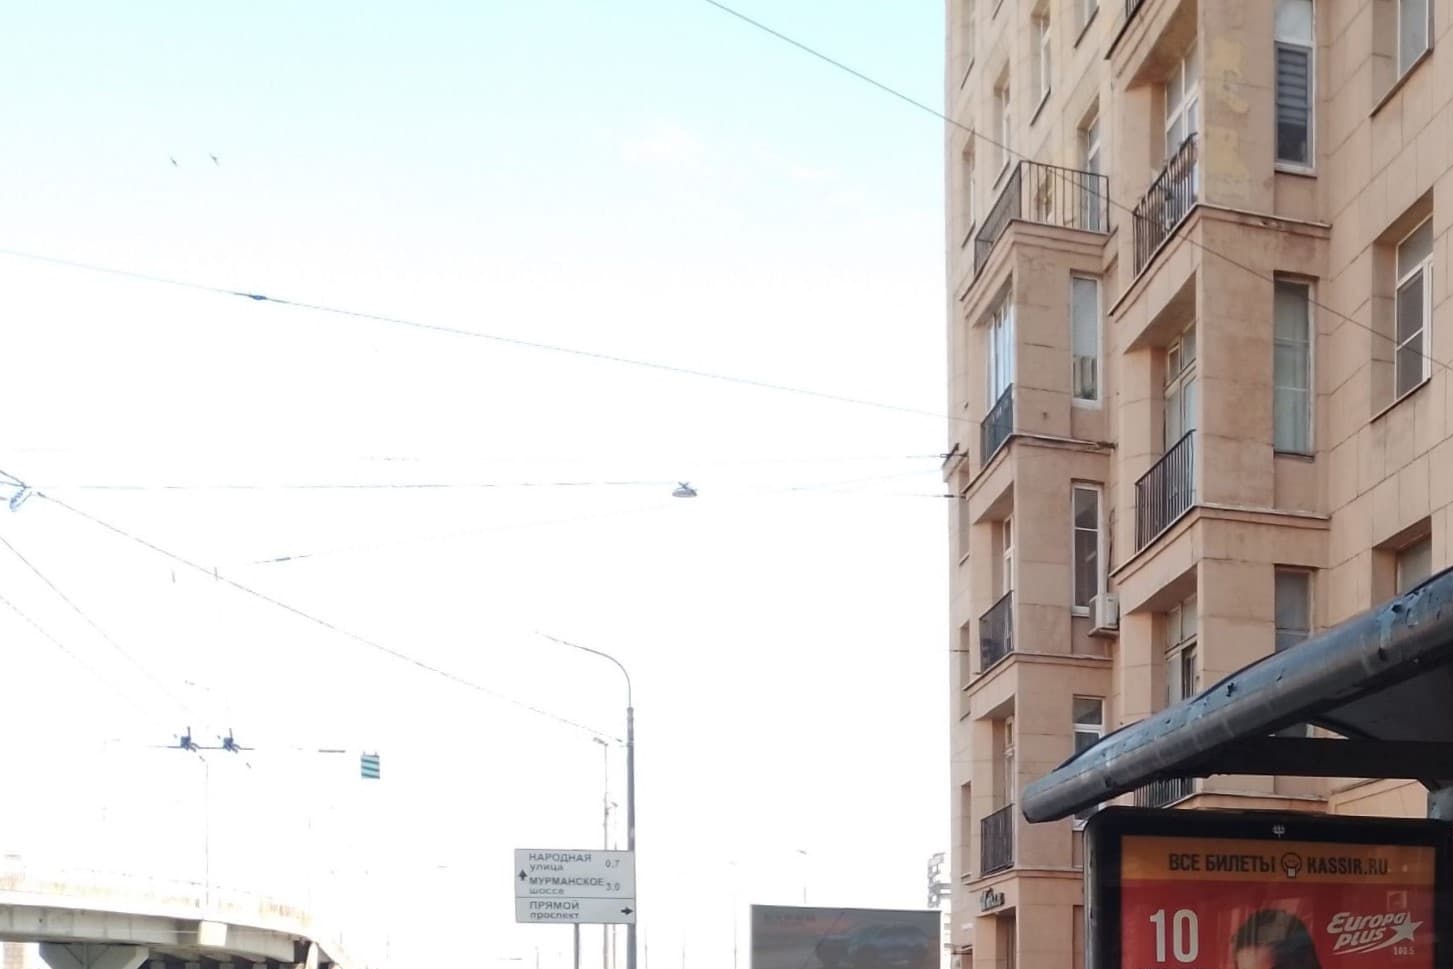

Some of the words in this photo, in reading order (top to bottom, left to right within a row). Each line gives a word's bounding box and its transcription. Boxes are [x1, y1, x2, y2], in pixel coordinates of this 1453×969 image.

[528, 853, 592, 863] НАРОДНАЯ
[1168, 853, 1201, 871] ВСЕ
[1205, 854, 1276, 872] БИЛЕТЫ
[529, 863, 564, 872] улица
[1307, 856, 1389, 876] KASSIR.RU
[529, 877, 605, 886] МУРМАНСКОЕ
[529, 900, 580, 910] ПРЯМОЙ
[530, 912, 579, 920] проспект
[1150, 909, 1200, 963] 10
